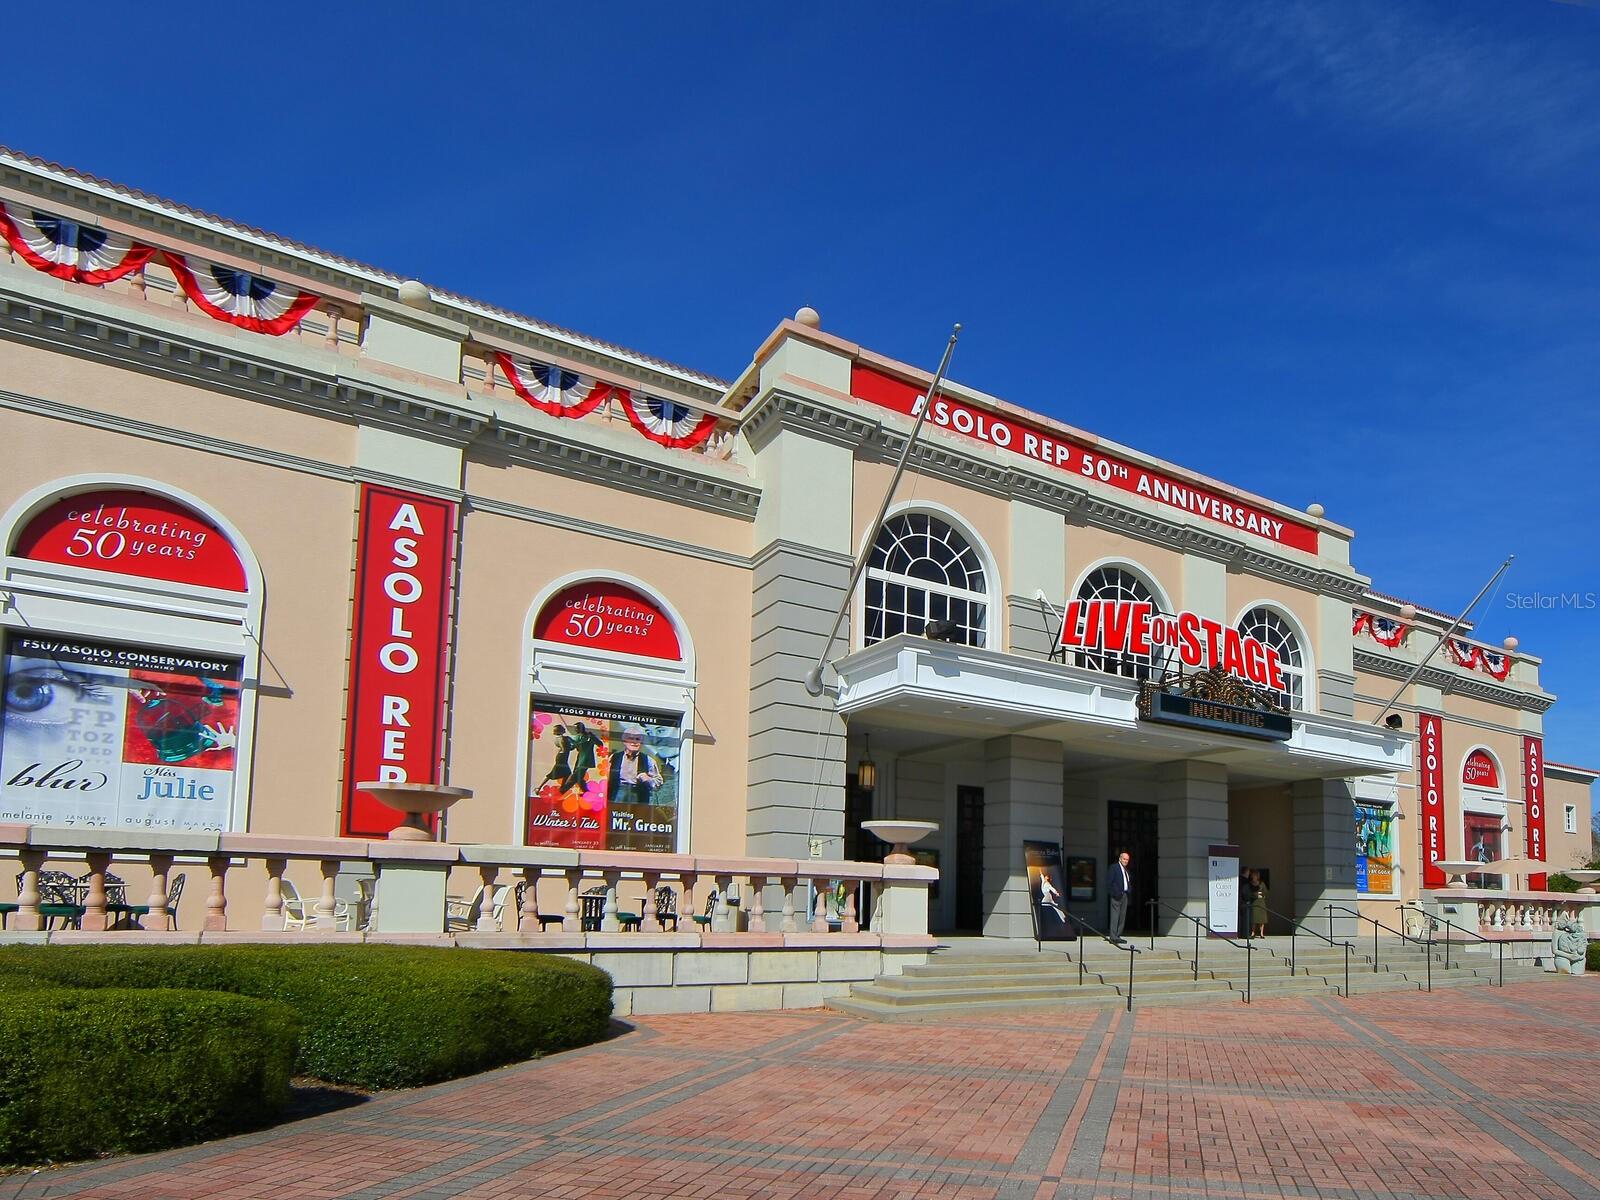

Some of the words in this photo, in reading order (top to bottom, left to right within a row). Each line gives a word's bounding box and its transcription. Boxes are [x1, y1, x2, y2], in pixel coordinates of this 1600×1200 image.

[910, 394, 1012, 447] ASOLO
[1024, 432, 1070, 466] REP
[1081, 453, 1129, 482] 50TH
[1136, 474, 1284, 540] ANNIVERSARY
[67, 504, 207, 548] celebrating
[66, 528, 126, 559] 50
[130, 540, 196, 560] years
[379, 503, 425, 674] ASOLO
[565, 593, 655, 626] celebrating
[565, 613, 603, 638] 50
[605, 622, 648, 636] years
[22, 640, 112, 657] FSU/ASOLO
[118, 651, 229, 672] CONSERVATORY
[1060, 599, 1153, 657] LIVE
[1150, 616, 1178, 649] ON
[1177, 610, 1286, 692] STAGE
[135, 662, 175, 671] TRAINING
[559, 707, 584, 715] ASOLO
[586, 710, 626, 720] REPERTORY
[629, 715, 657, 724] THEATRE
[6, 759, 108, 792] blur
[143, 766, 177, 777] Miss
[1426, 720, 1438, 805] ASOLO
[1466, 767, 1476, 780] 50
[137, 776, 215, 801] Julie
[1529, 742, 1540, 819] ASOLO
[2, 810, 53, 821] melanie
[65, 814, 107, 822] JANUARY
[125, 817, 175, 826] august
[533, 814, 577, 828] Winter's
[580, 817, 600, 829] Tale
[612, 818, 631, 831] Mr.
[635, 819, 672, 833] Green
[1429, 815, 1438, 863] REP
